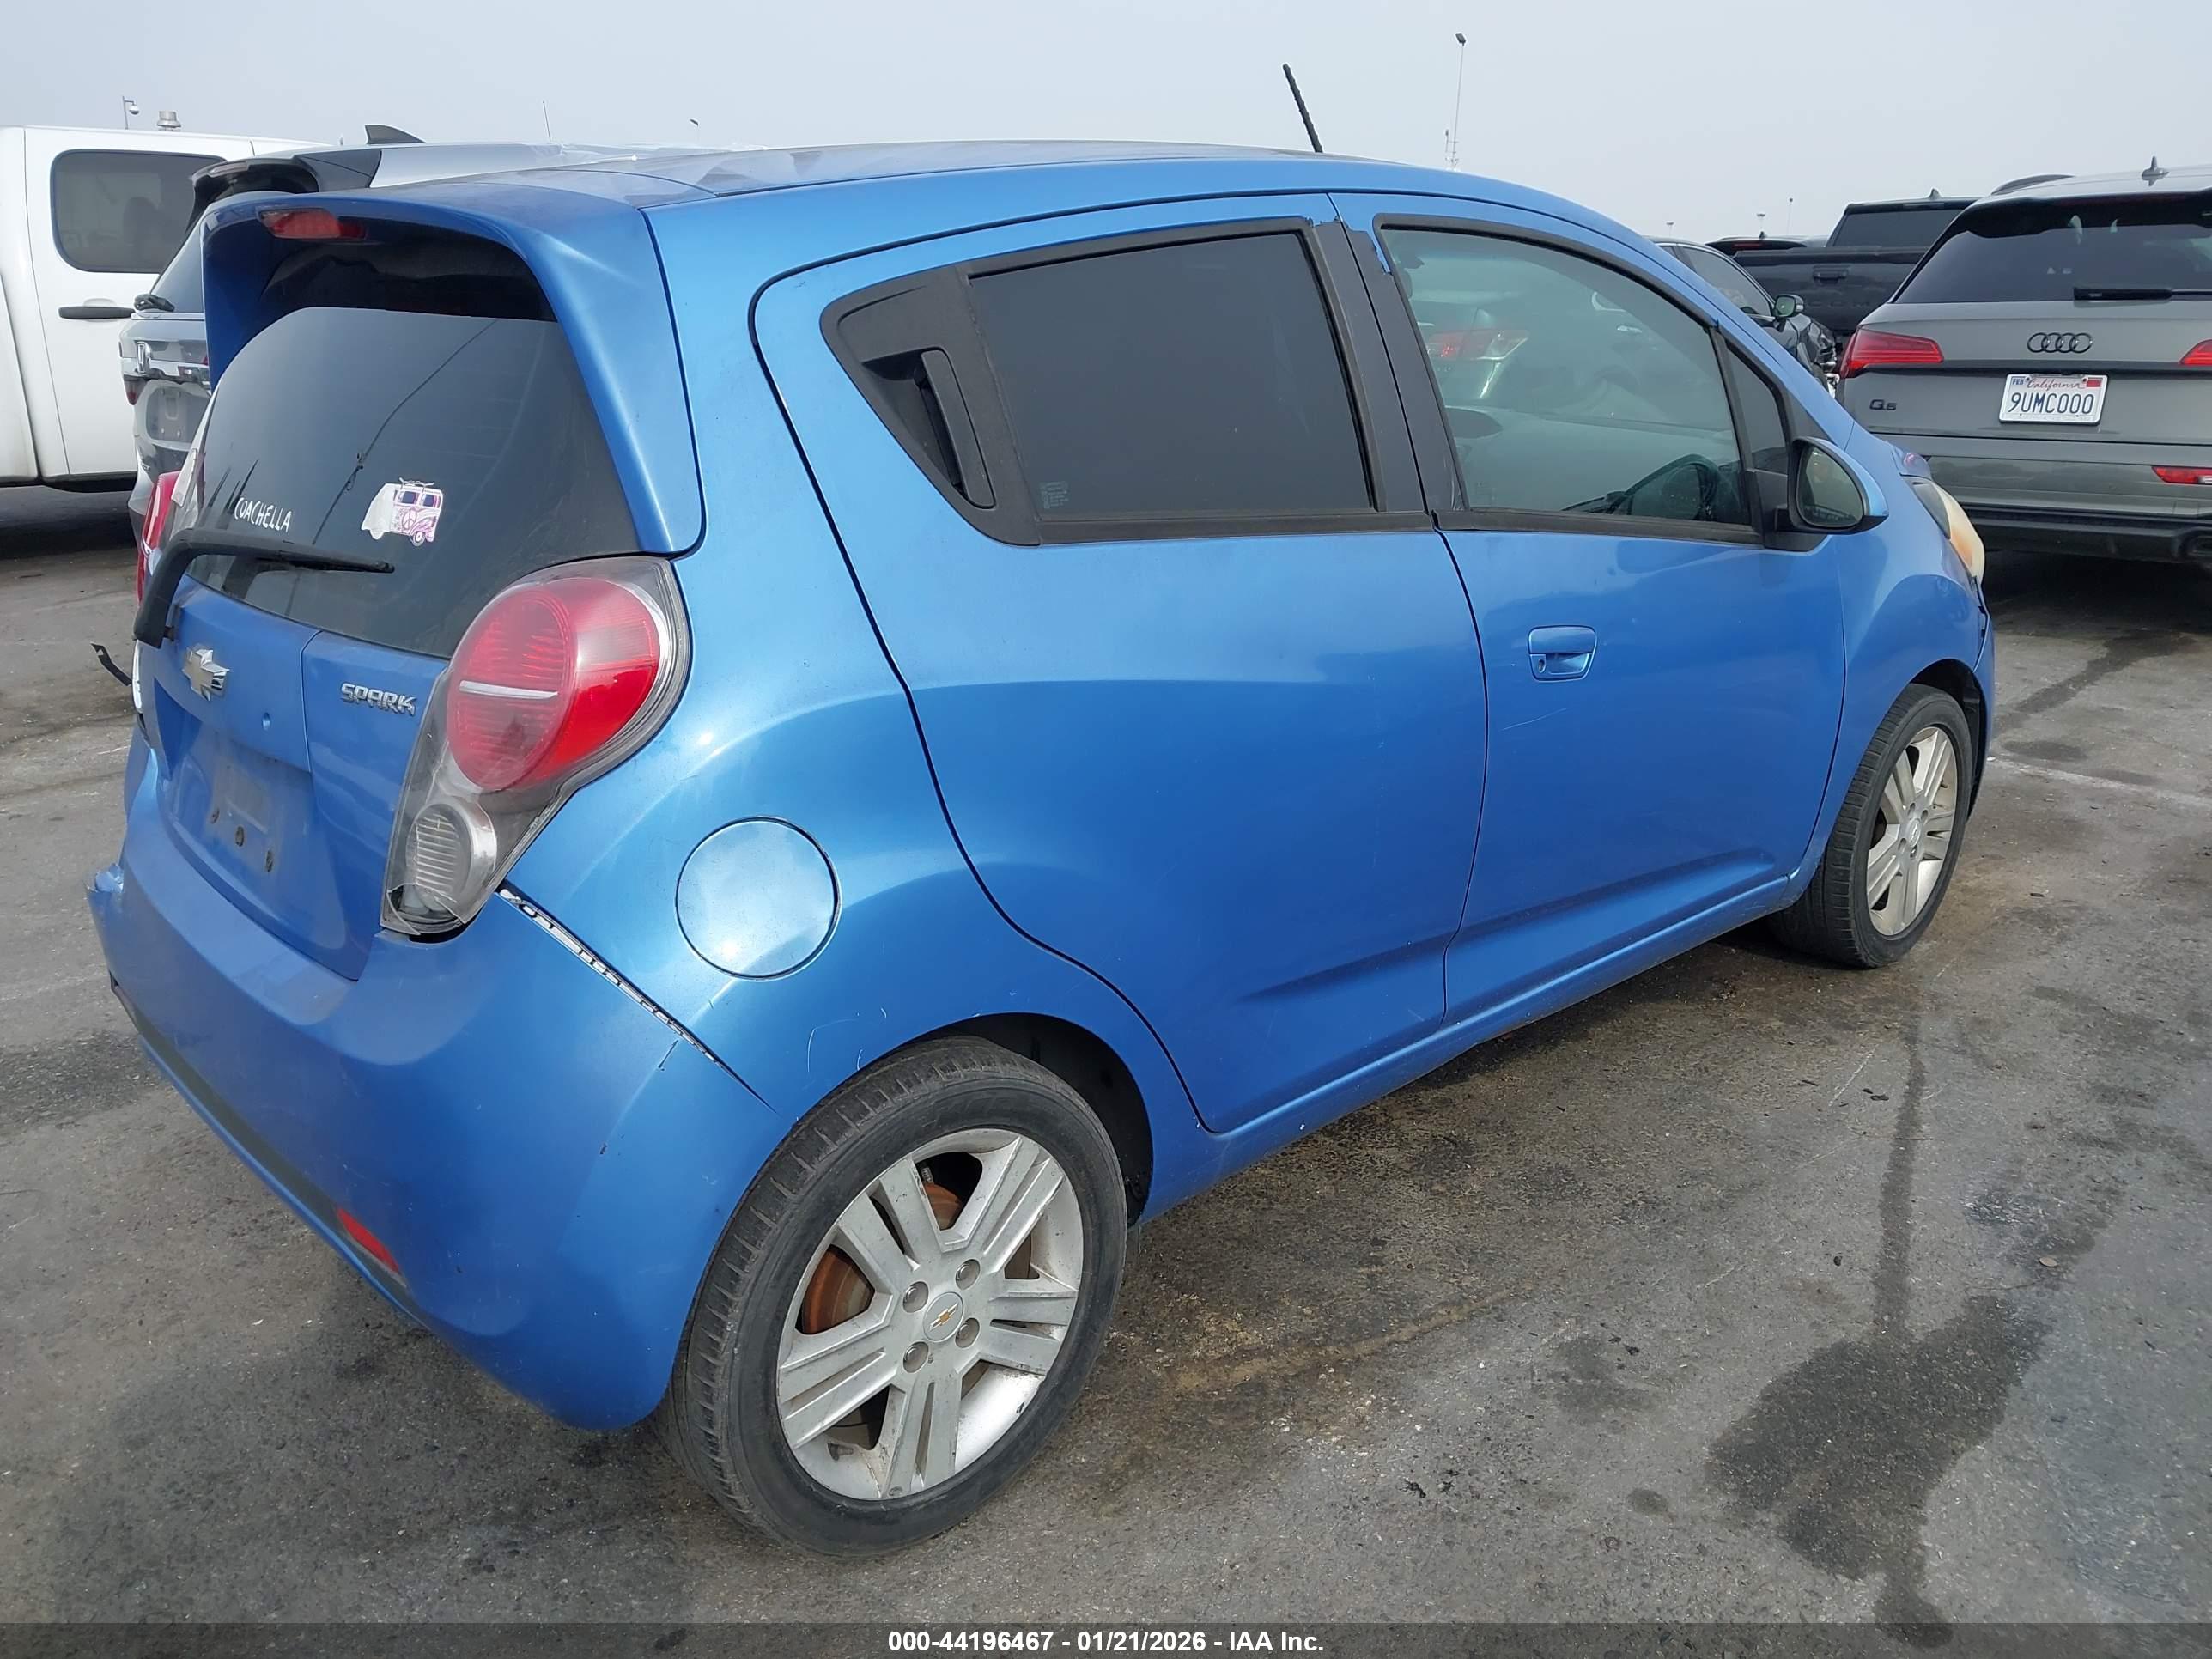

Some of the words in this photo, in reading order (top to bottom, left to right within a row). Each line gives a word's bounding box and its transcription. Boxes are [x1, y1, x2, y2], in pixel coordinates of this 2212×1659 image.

[2027, 378, 2085, 392] California
[1869, 398, 1897, 411] Q5
[2008, 392, 2095, 414] 9UMC000
[234, 497, 292, 532] COACHELLA
[341, 682, 417, 716] SPARK
